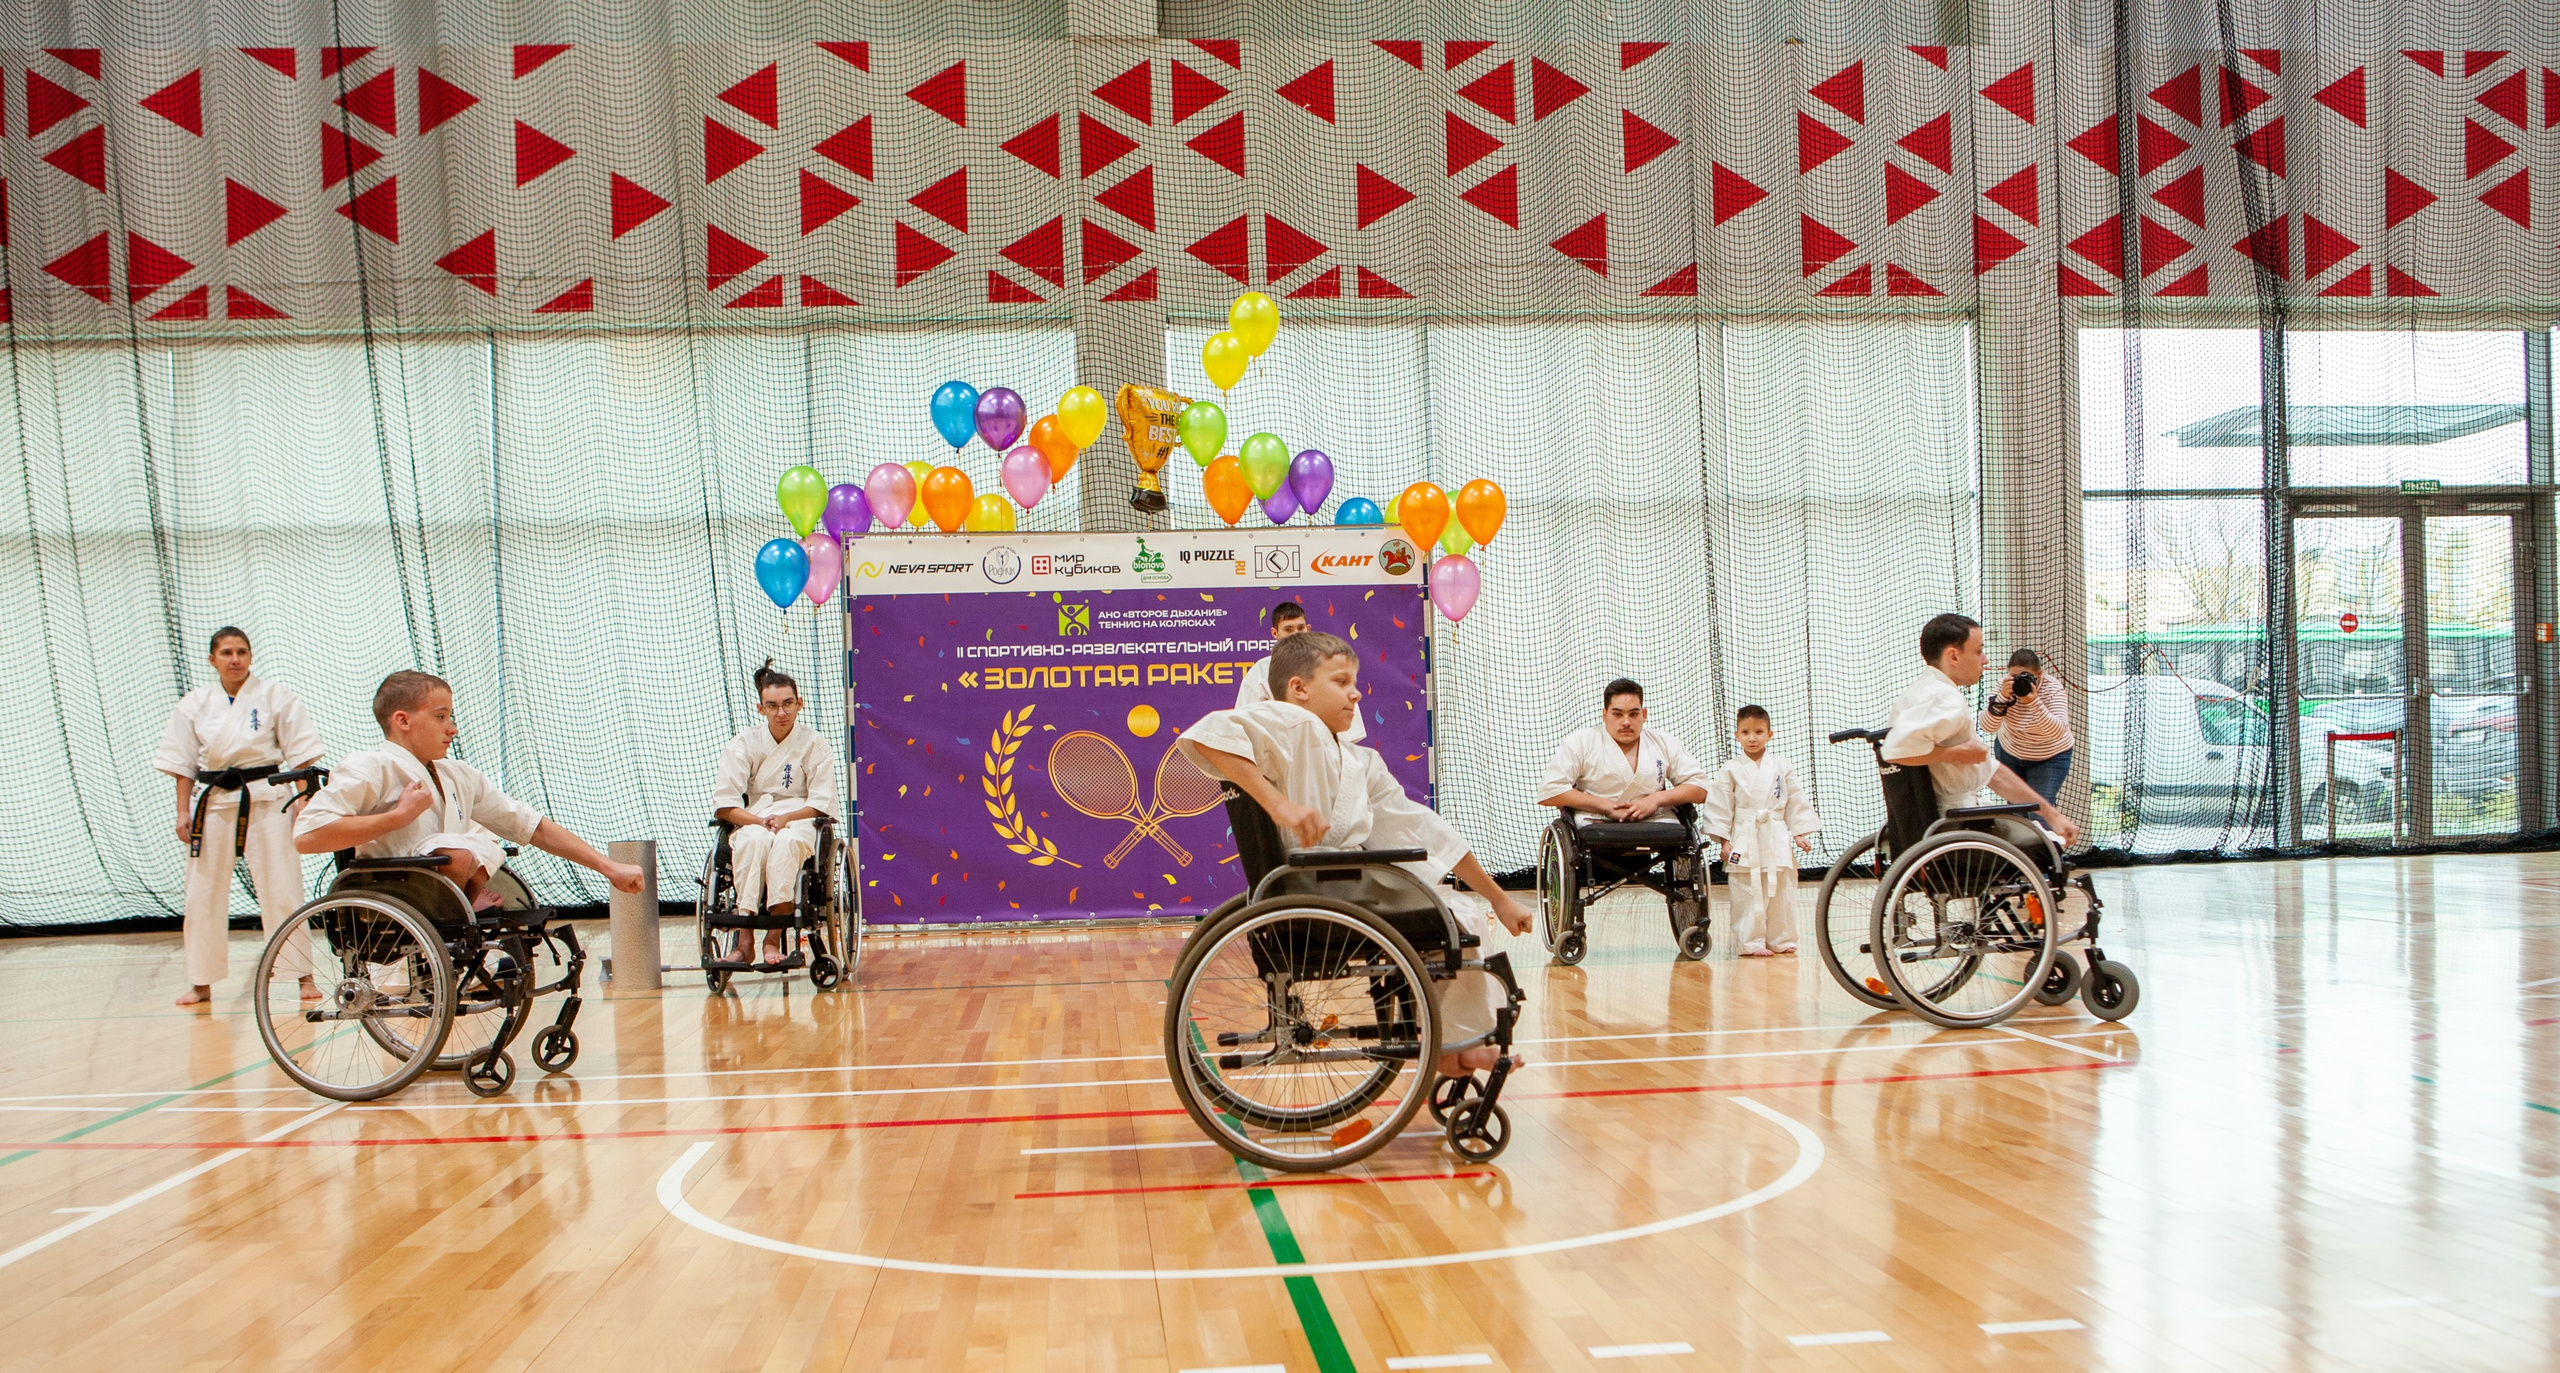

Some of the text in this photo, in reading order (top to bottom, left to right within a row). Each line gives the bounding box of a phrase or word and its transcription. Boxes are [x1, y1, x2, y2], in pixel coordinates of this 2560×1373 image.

[1160, 413, 1175, 426] THE
[1148, 425, 1176, 444] BEST
[1156, 446, 1170, 460] #1
[1179, 549, 1235, 562] IQ PUZZLE
[1321, 555, 1374, 567] КАНТ
[888, 562, 974, 575] NEVA SPORT
[1132, 560, 1166, 570] bionova
[1234, 560, 1246, 576] RU
[1098, 609, 1228, 620] АНО «ВТОРОЕ ДЫХАНИЕ»
[1098, 619, 1216, 629] ТЕННИС НА КОЛЯСКАХ
[967, 638, 1234, 658] СПОРТИВНО-РАЗВЛЕКАТЕЛЬНЫЙ
